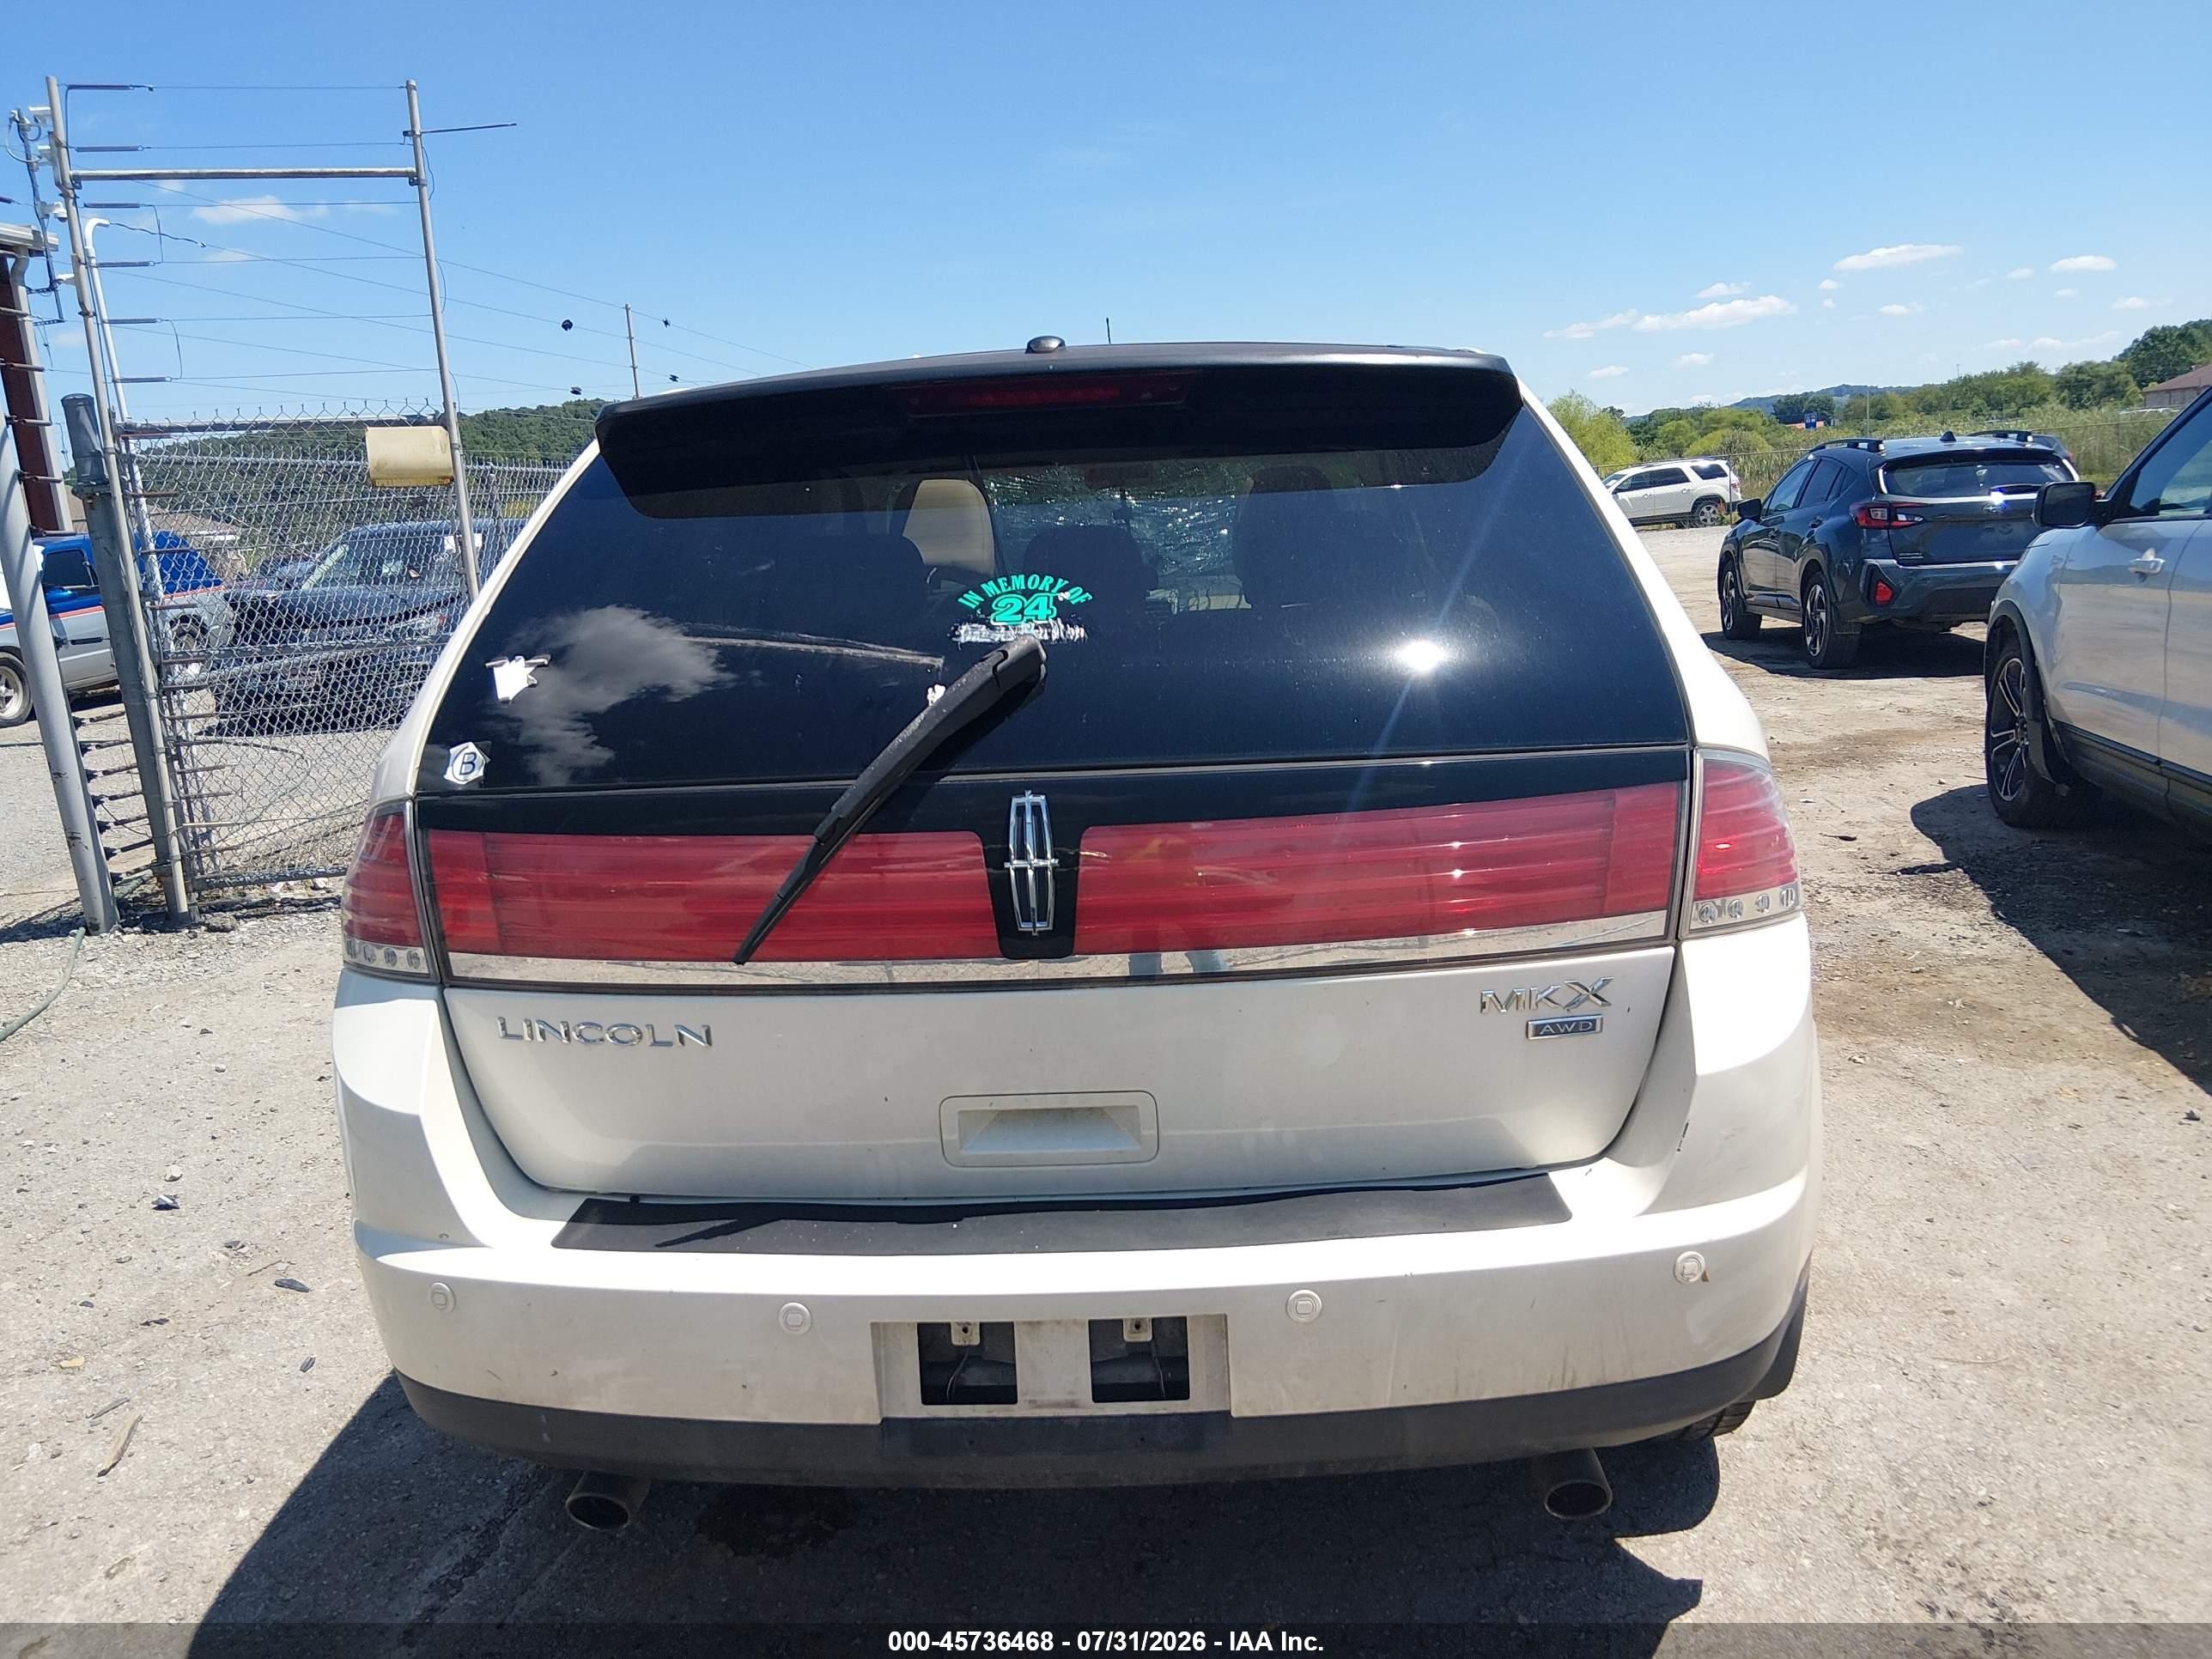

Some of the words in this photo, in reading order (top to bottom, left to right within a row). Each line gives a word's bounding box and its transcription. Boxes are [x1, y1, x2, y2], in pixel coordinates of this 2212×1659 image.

[957, 590, 985, 610] IN
[980, 574, 1069, 598] MEMORY
[1067, 586, 1093, 605] OF
[991, 593, 1056, 624] 24
[459, 751, 477, 775] B
[1480, 976, 1614, 1013] MKX
[497, 1016, 713, 1047] LINCOLN
[1539, 1021, 1594, 1035] AWD
